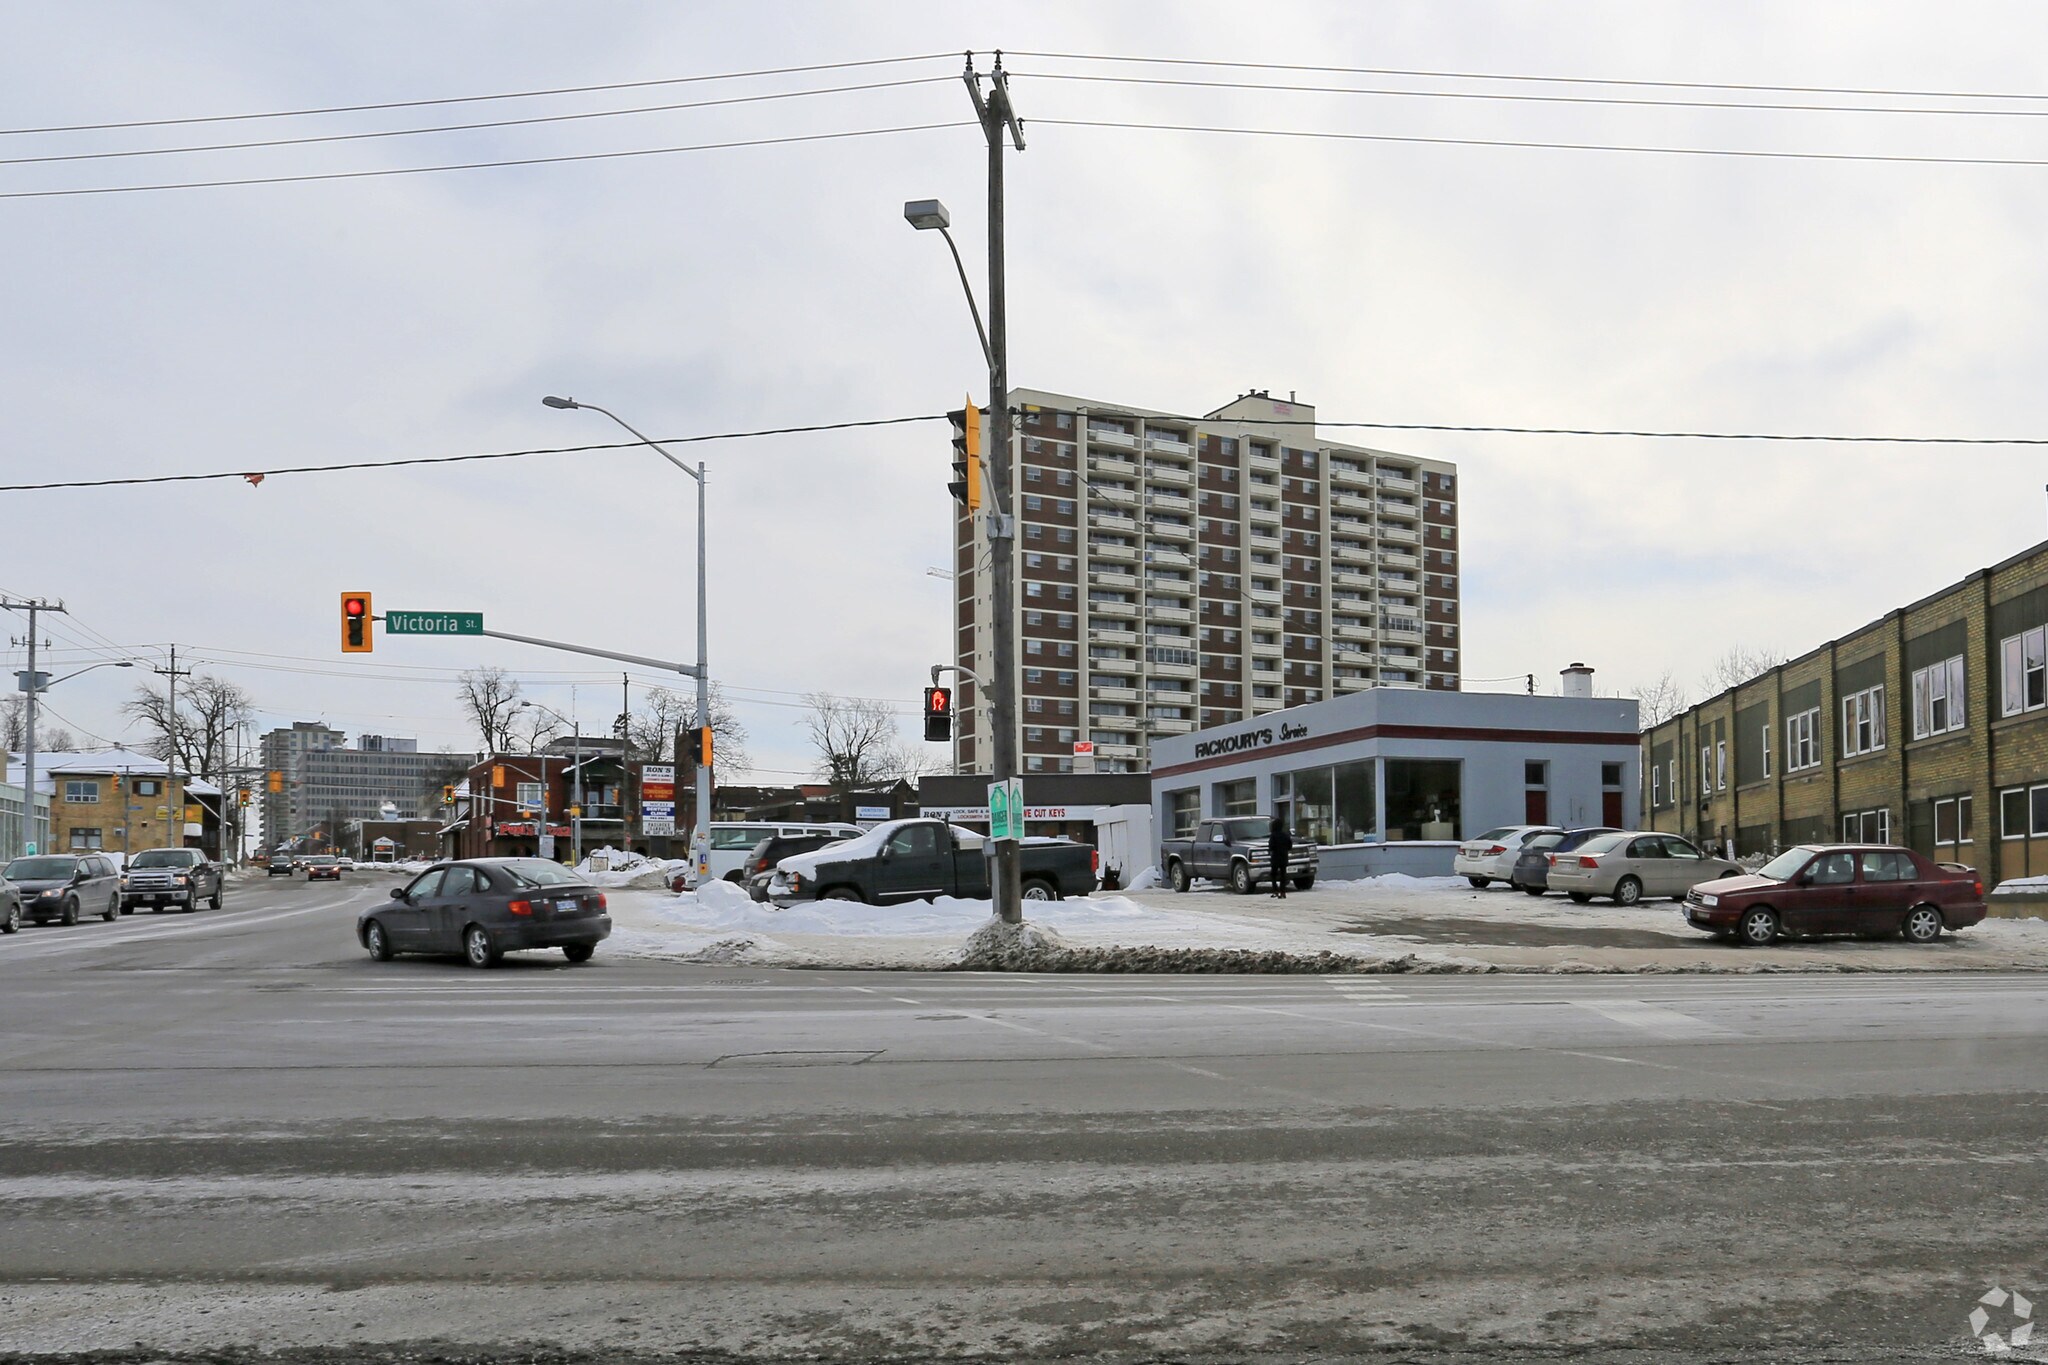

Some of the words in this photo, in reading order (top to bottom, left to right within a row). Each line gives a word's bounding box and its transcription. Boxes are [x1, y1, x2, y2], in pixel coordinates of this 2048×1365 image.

[392, 615, 458, 631] Victoria
[465, 620, 477, 628] St.
[1195, 728, 1273, 758] FACKOURY'S
[1279, 722, 1308, 741] Service
[1034, 809, 1046, 818] CUT
[1048, 809, 1066, 818] KEYS
